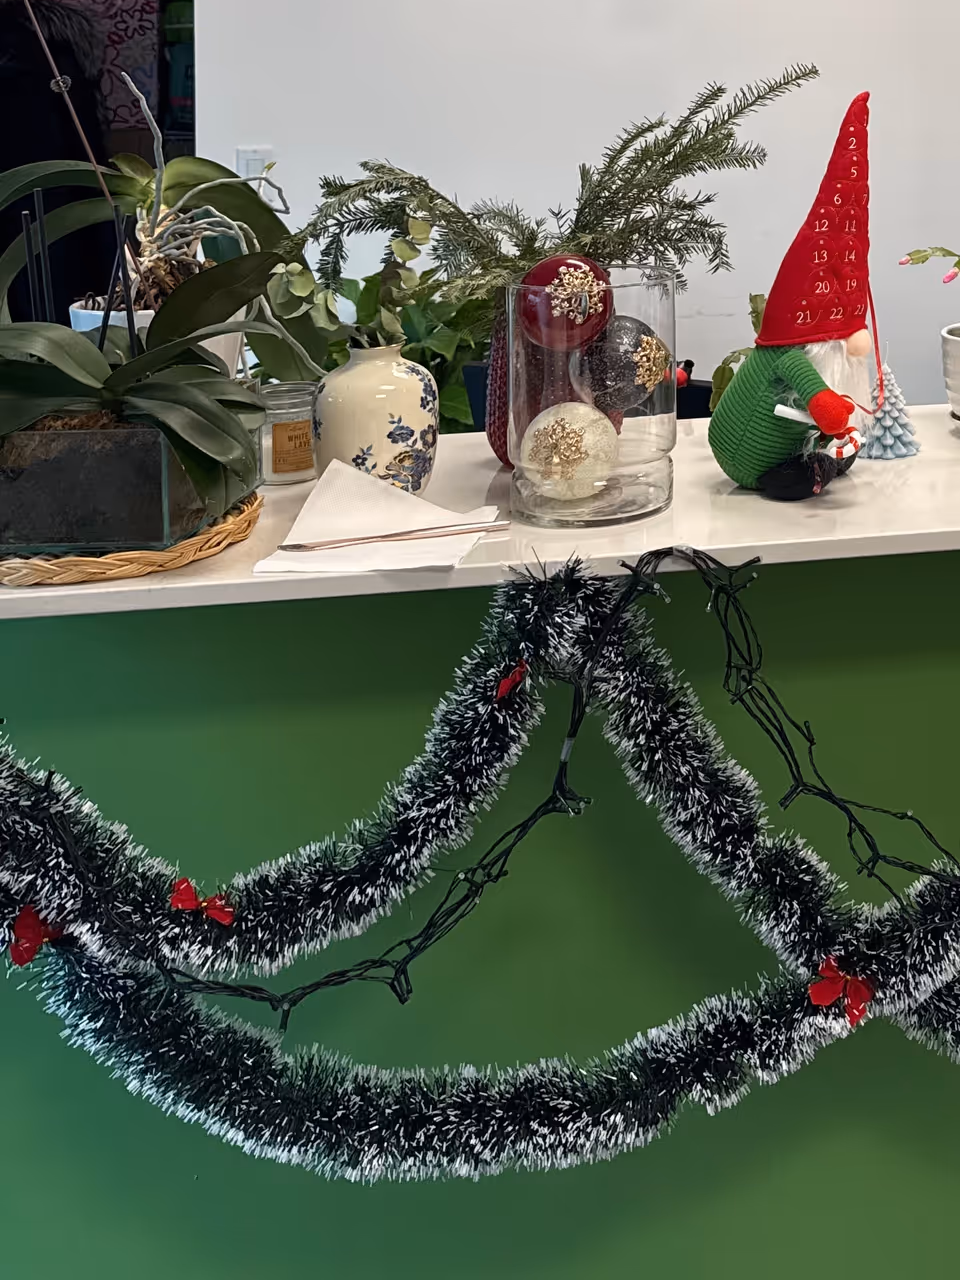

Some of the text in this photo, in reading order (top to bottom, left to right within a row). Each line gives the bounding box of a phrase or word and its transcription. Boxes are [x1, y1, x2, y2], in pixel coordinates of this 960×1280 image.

[848, 137, 857, 149] 2
[850, 166, 858, 178] 5
[834, 193, 842, 204] 6
[814, 219, 856, 232] 12 11
[812, 250, 856, 263] 13 14
[814, 279, 857, 293] 20 19
[796, 310, 811, 323] 21
[829, 307, 843, 319] 22
